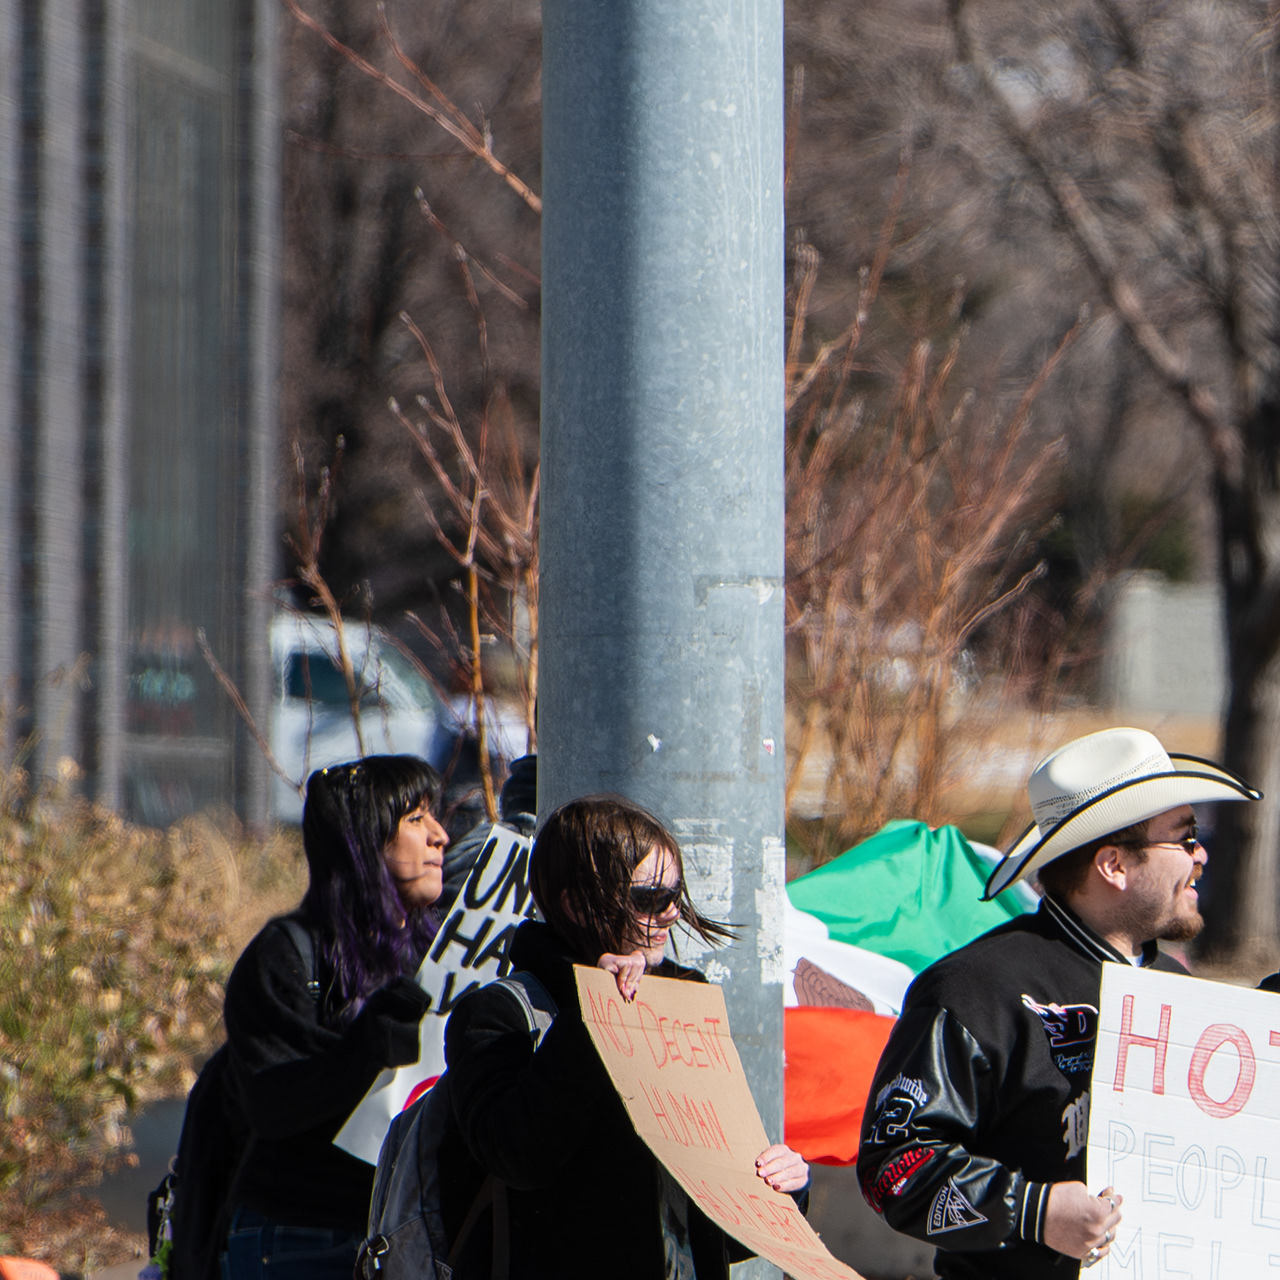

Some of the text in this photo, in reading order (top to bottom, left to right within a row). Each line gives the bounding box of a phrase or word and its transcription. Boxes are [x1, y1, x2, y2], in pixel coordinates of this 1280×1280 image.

[463, 836, 535, 918] UN
[587, 986, 732, 1073] NO DECENT
[638, 1077, 734, 1159] HUMAN
[932, 1185, 950, 1227] EDITION
